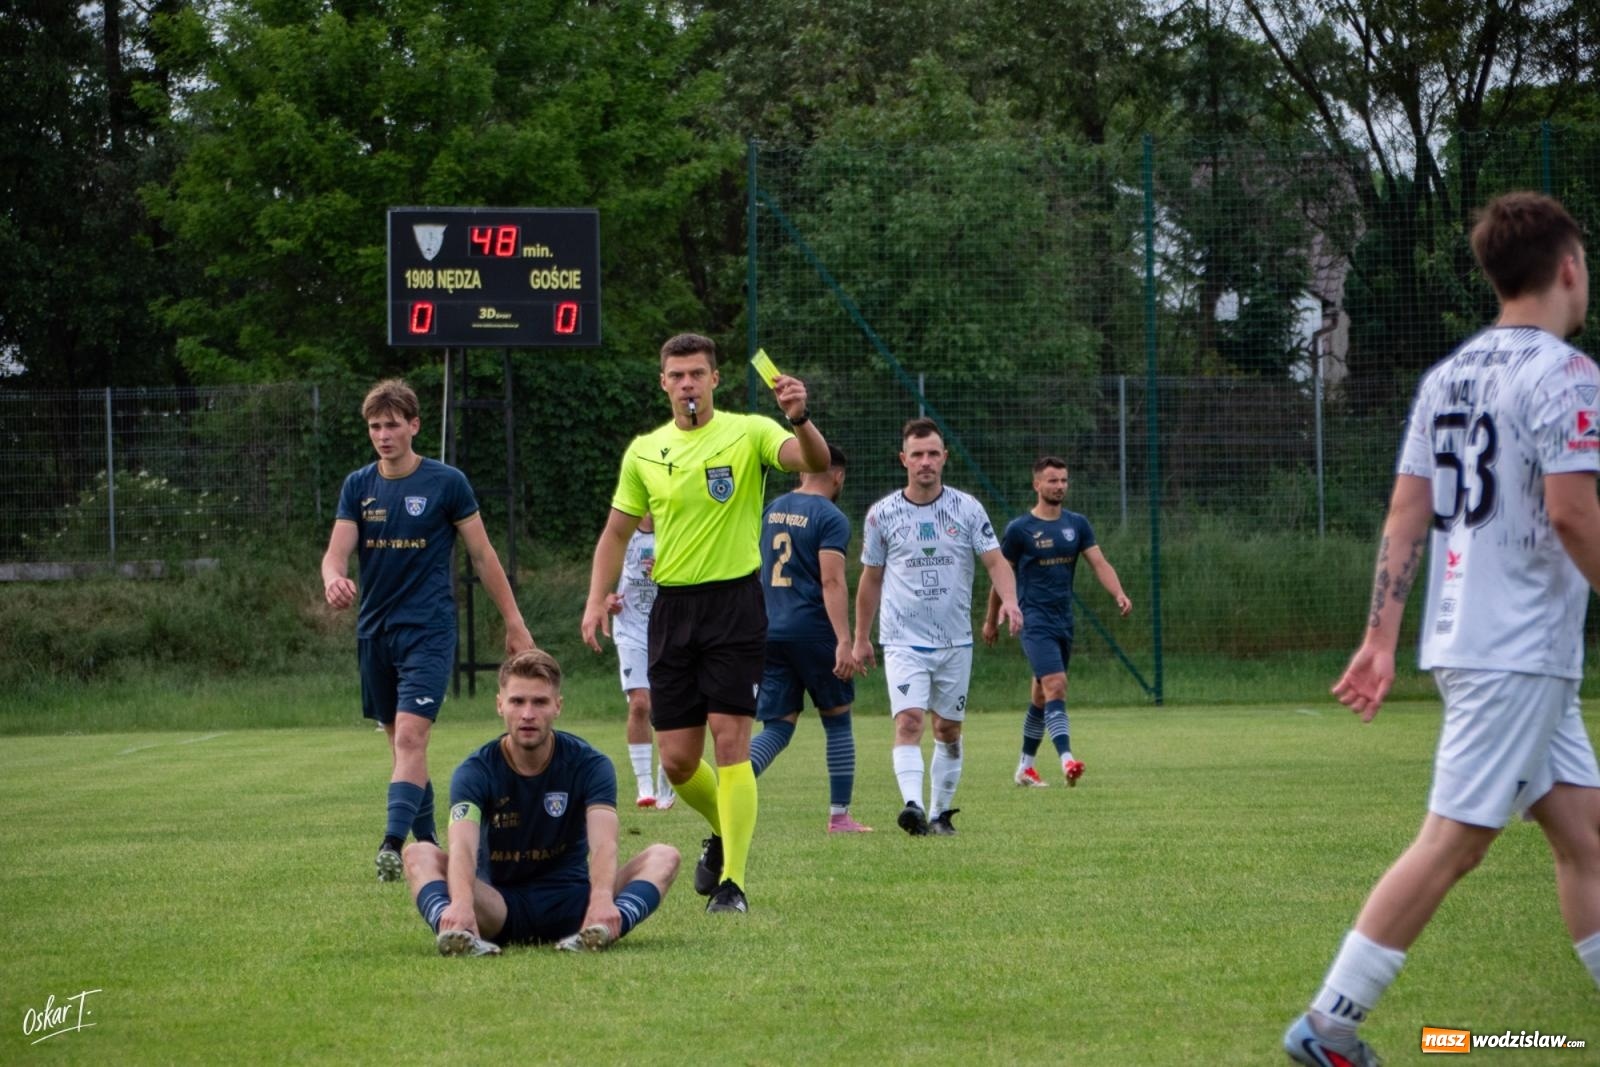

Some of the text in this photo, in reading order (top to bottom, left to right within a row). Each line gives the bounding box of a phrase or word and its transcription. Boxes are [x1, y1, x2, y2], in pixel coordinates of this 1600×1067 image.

[472, 225, 554, 258] 48 min.
[405, 270, 482, 294] 1908 NĘDZA
[529, 265, 582, 290] GOŚCIE
[410, 301, 434, 335] 0
[554, 301, 579, 335] 0
[771, 531, 793, 588] 2
[905, 556, 955, 569] WENINGER
